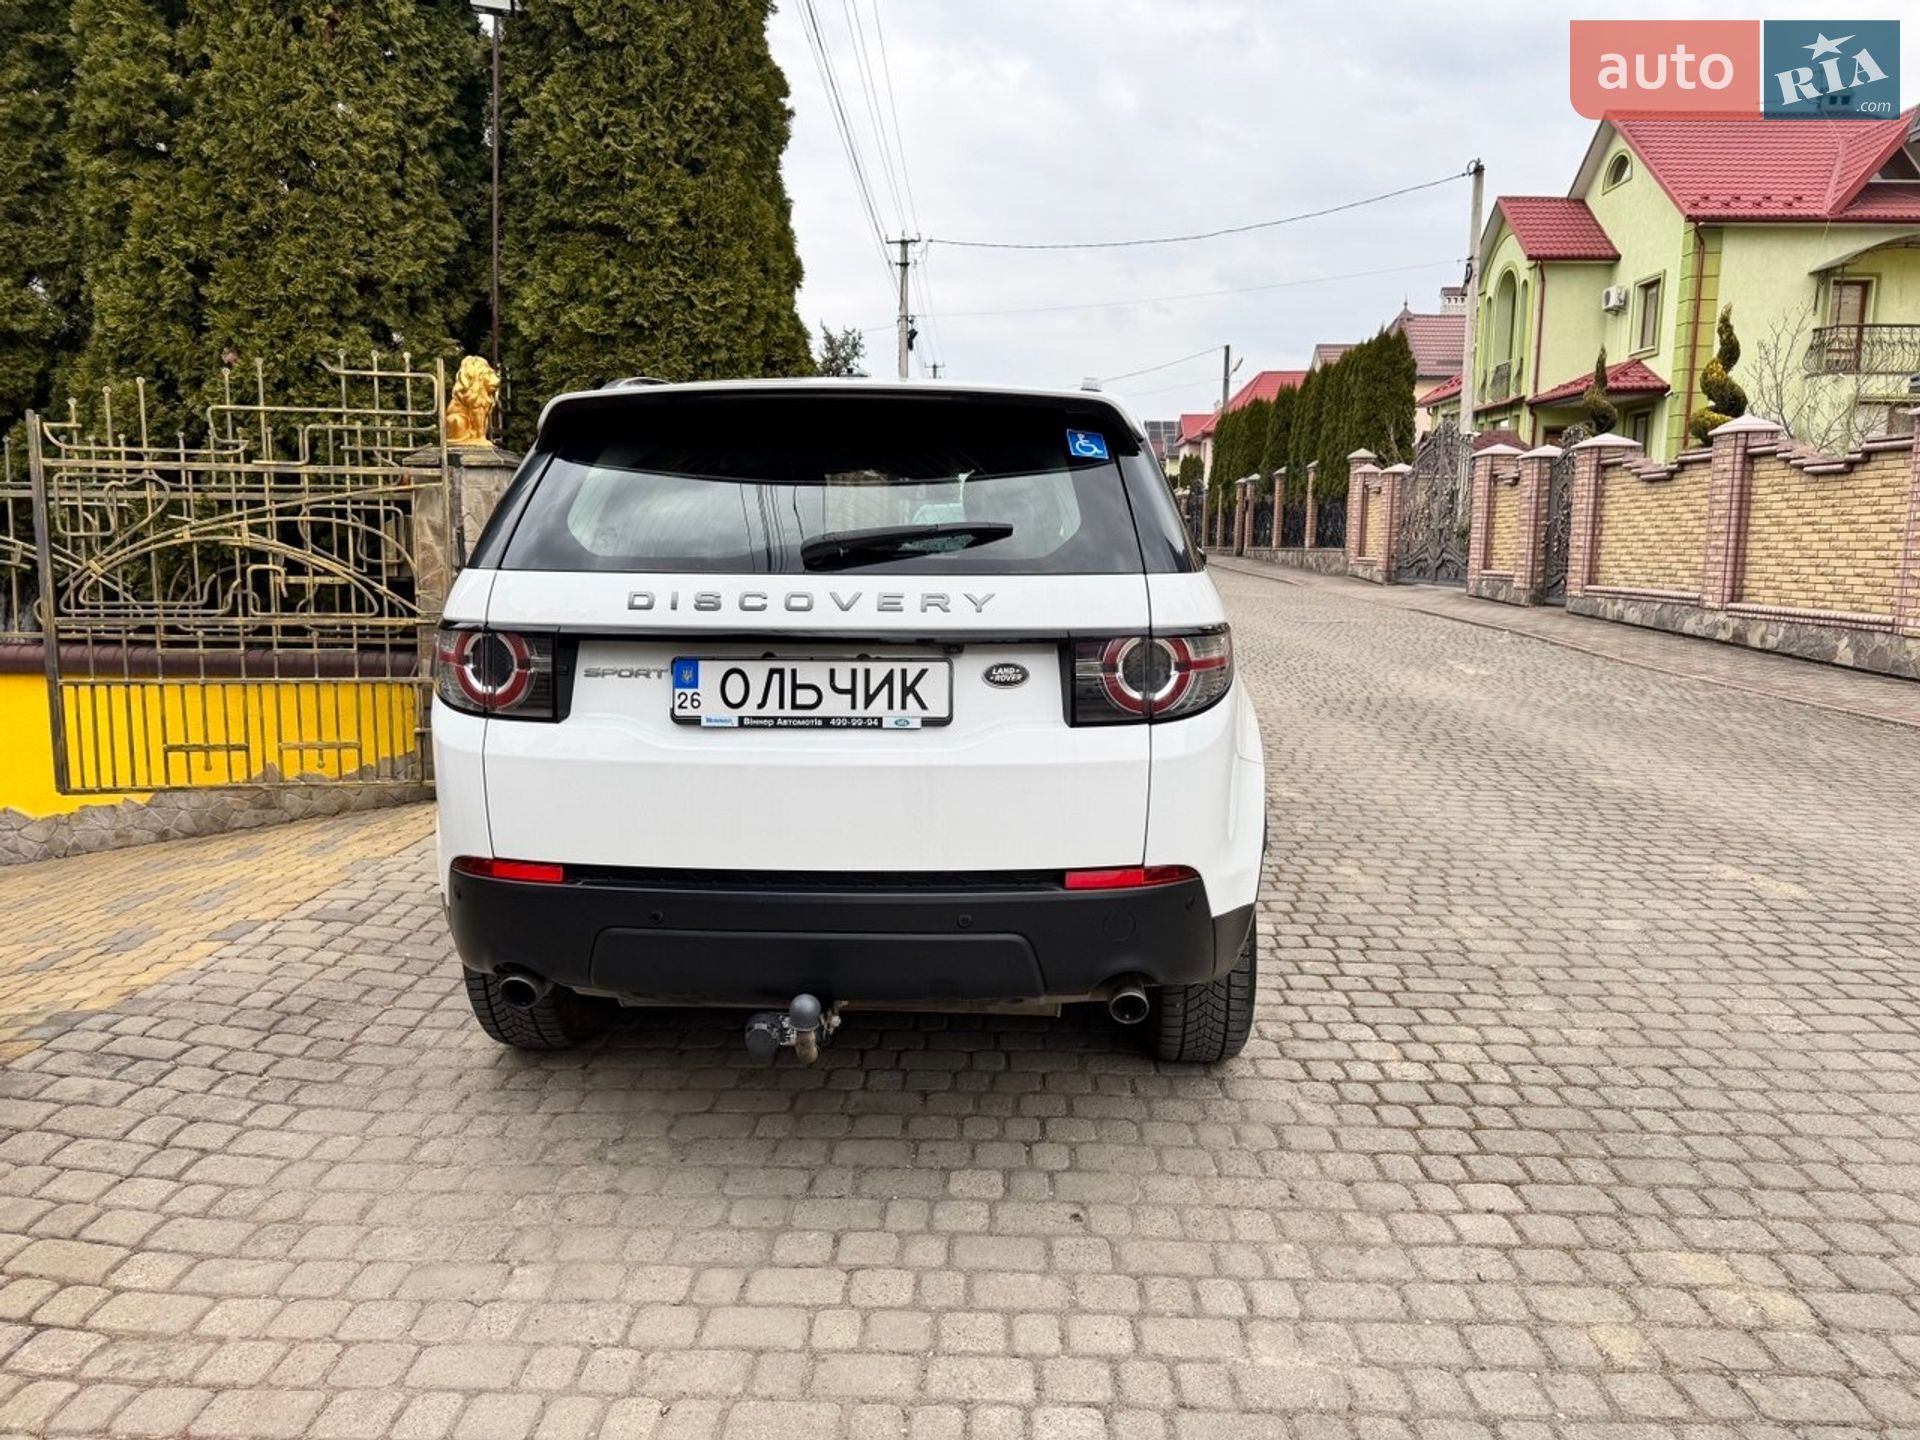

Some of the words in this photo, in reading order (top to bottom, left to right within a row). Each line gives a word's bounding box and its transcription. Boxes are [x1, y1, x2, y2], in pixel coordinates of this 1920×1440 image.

[628, 591, 996, 613] DISCOVERY
[584, 667, 668, 680] SPORT
[992, 667, 1015, 675] LAND
[720, 667, 929, 710] ОЛЬЧИК
[677, 692, 701, 709] 26
